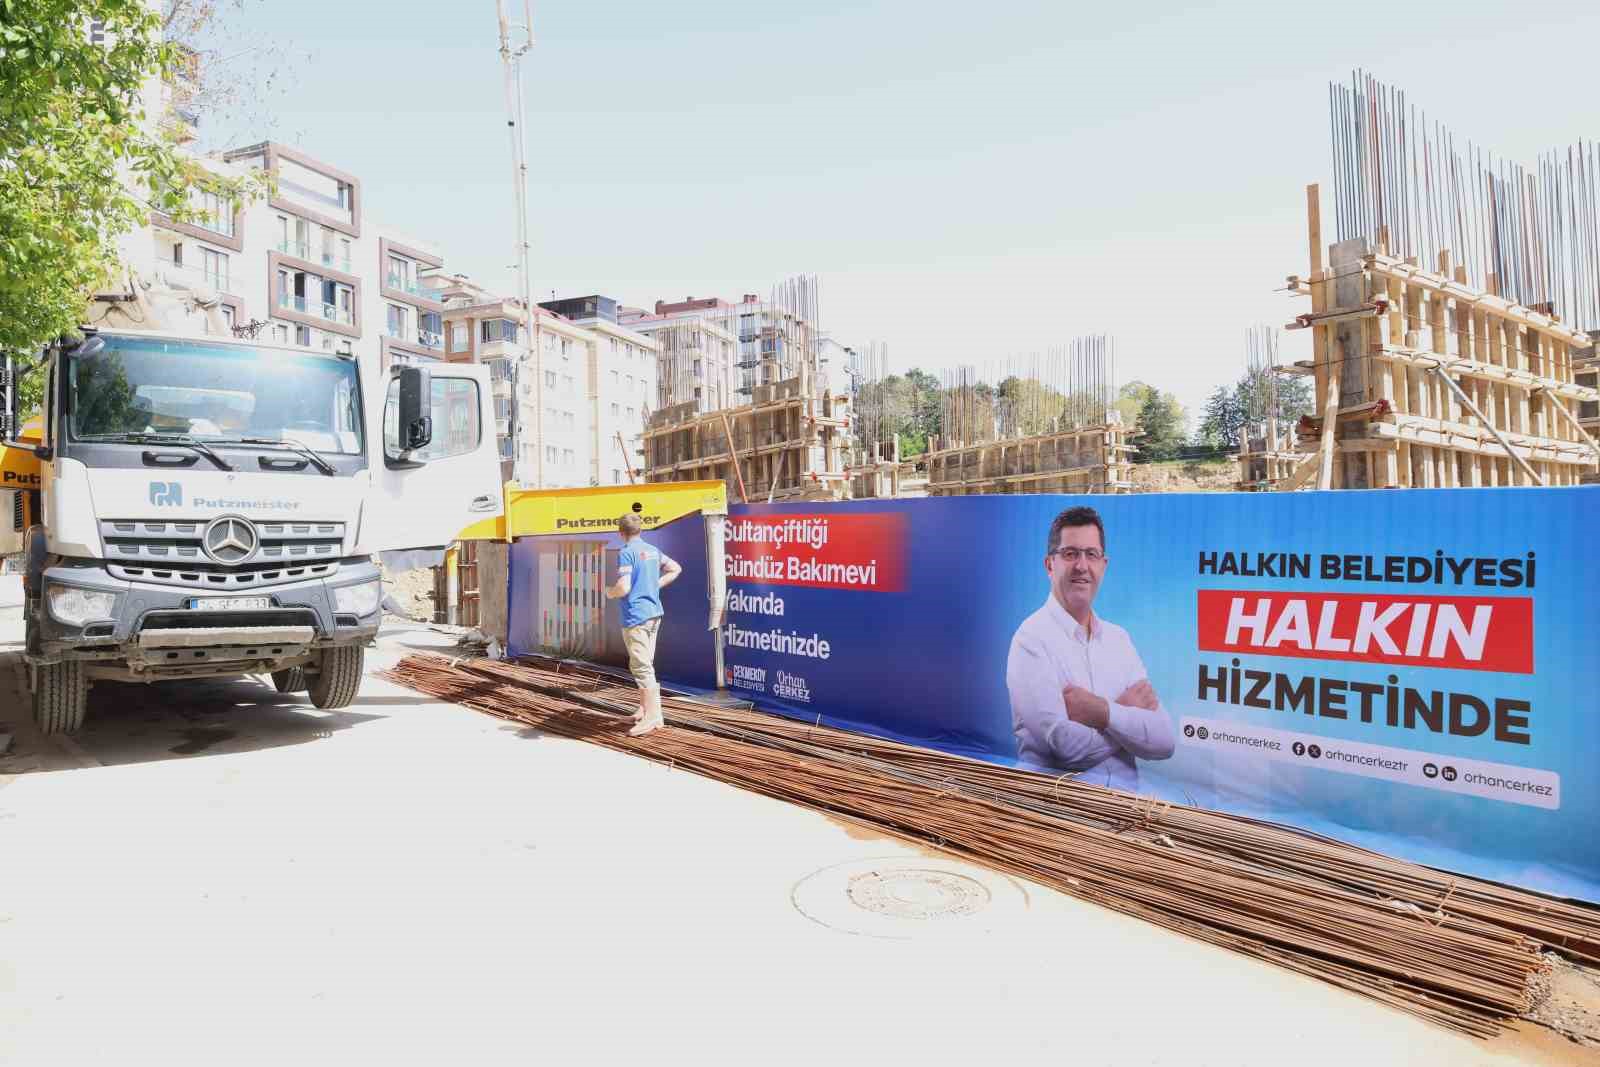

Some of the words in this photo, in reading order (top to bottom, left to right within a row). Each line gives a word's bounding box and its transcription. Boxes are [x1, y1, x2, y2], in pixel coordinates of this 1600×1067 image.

[193, 497, 301, 510] Putzmeister
[556, 515, 661, 529] Putzmeer
[724, 519, 829, 549] Sultançiftliği
[724, 554, 784, 579] Gündüz
[787, 556, 877, 585] Bakımevi
[1199, 551, 1311, 579] HALKIN
[1320, 550, 1536, 588] BELEDİYESİ
[1224, 597, 1494, 662] HALKIN
[1198, 658, 1532, 745] HİZMETİNDE
[1212, 730, 1281, 751] orhanncerkez
[1325, 749, 1409, 772] orhancerkeztr
[1464, 772, 1553, 797] orhancerkez
